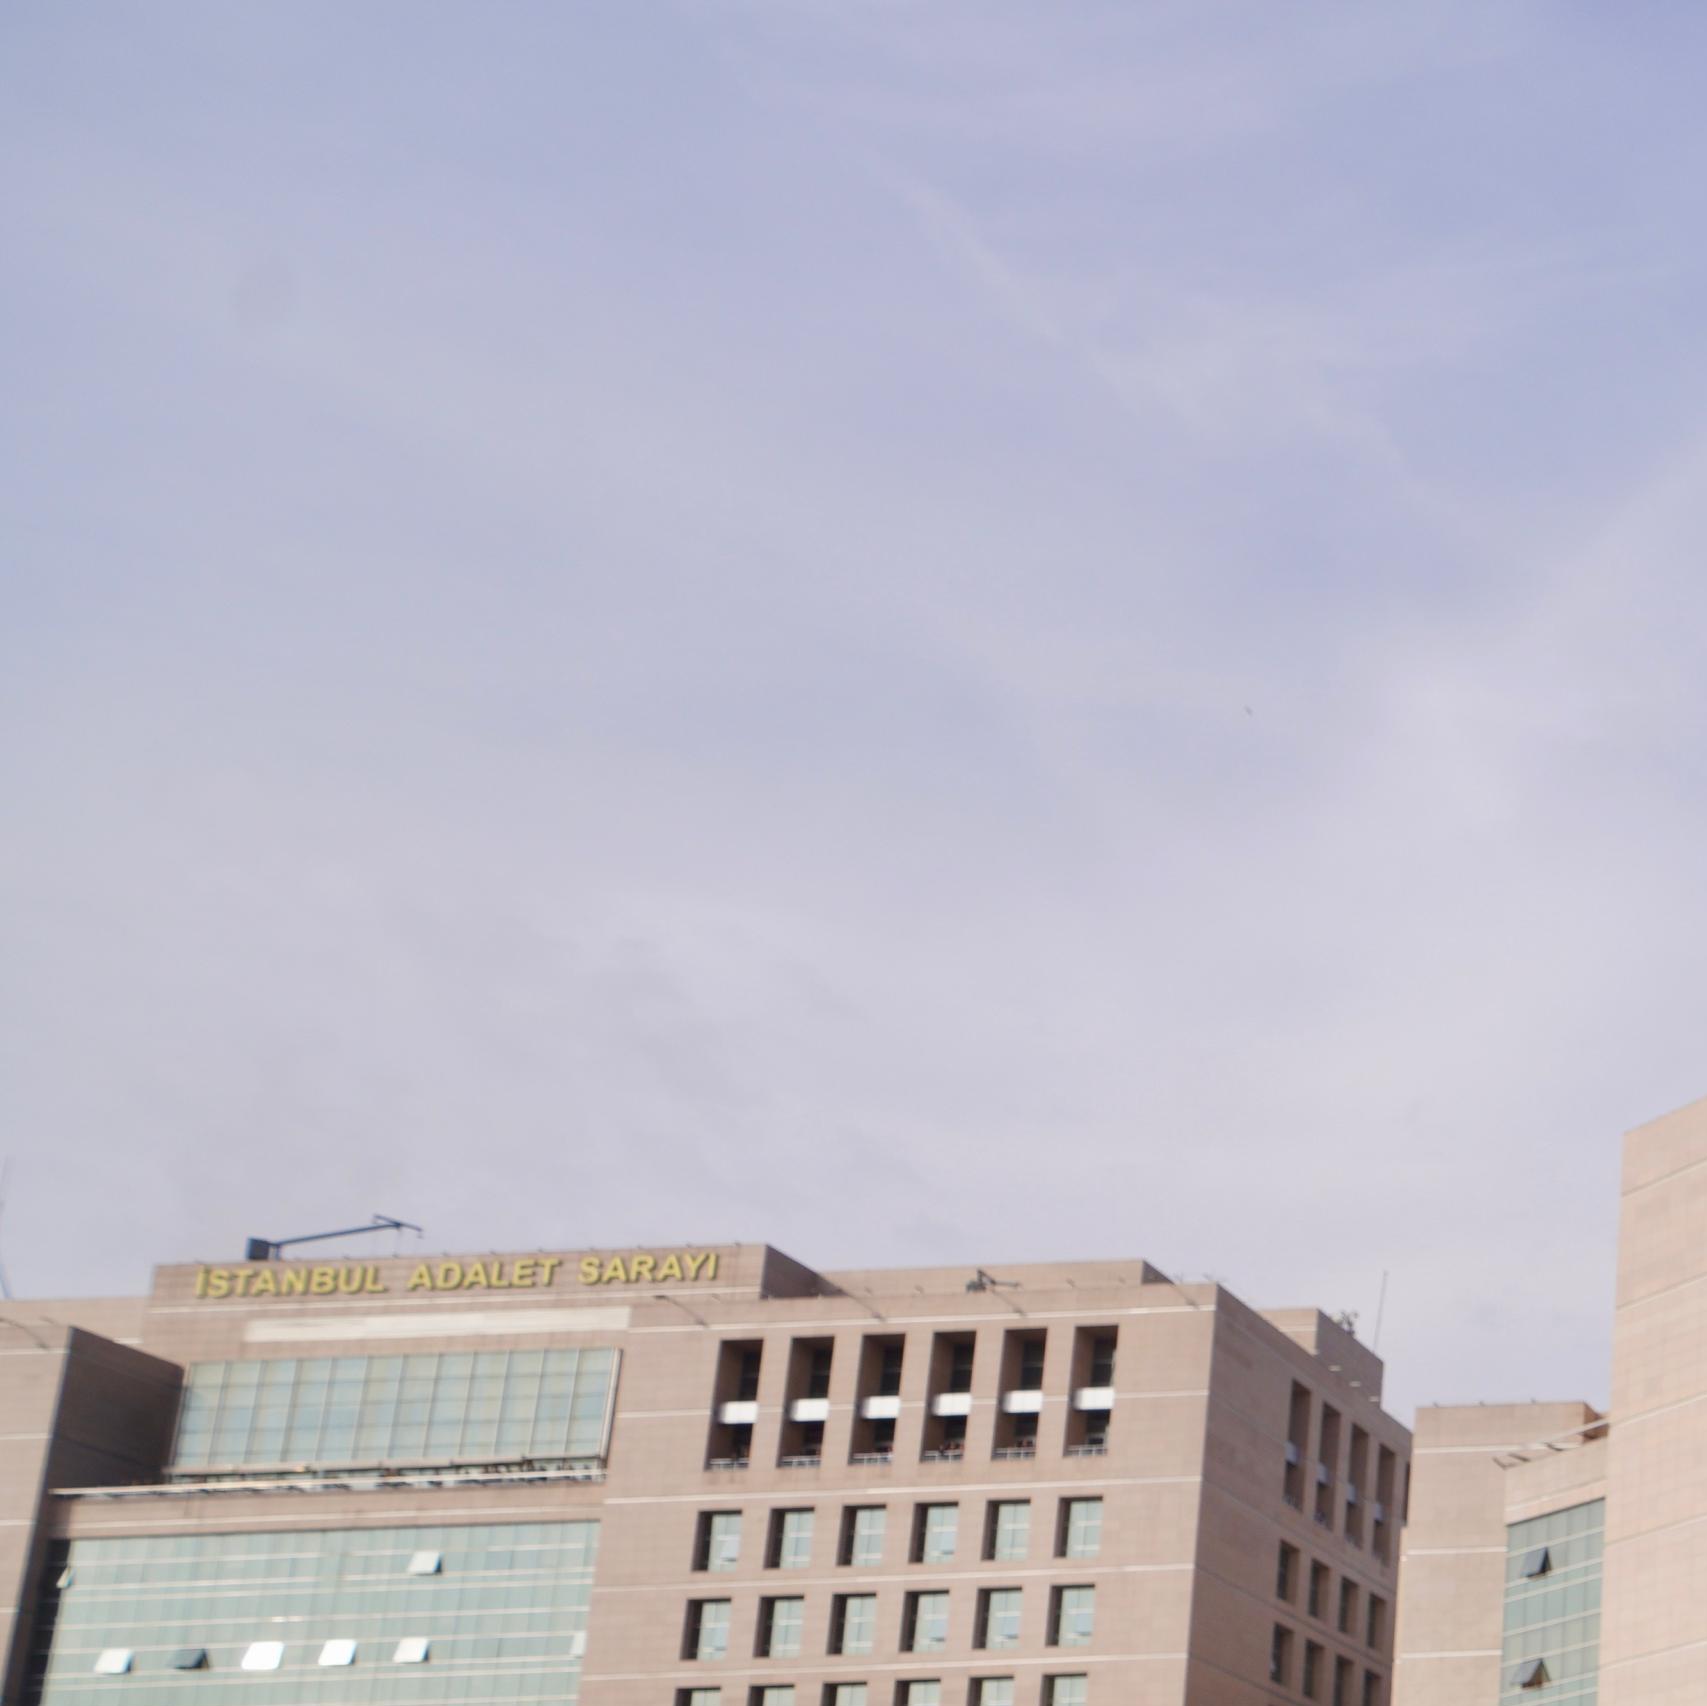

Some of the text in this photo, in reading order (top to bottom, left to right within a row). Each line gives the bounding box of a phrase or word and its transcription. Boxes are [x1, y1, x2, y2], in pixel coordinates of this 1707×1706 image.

[197, 1252, 718, 1298] İSTANBUL ADALET SARAYI
